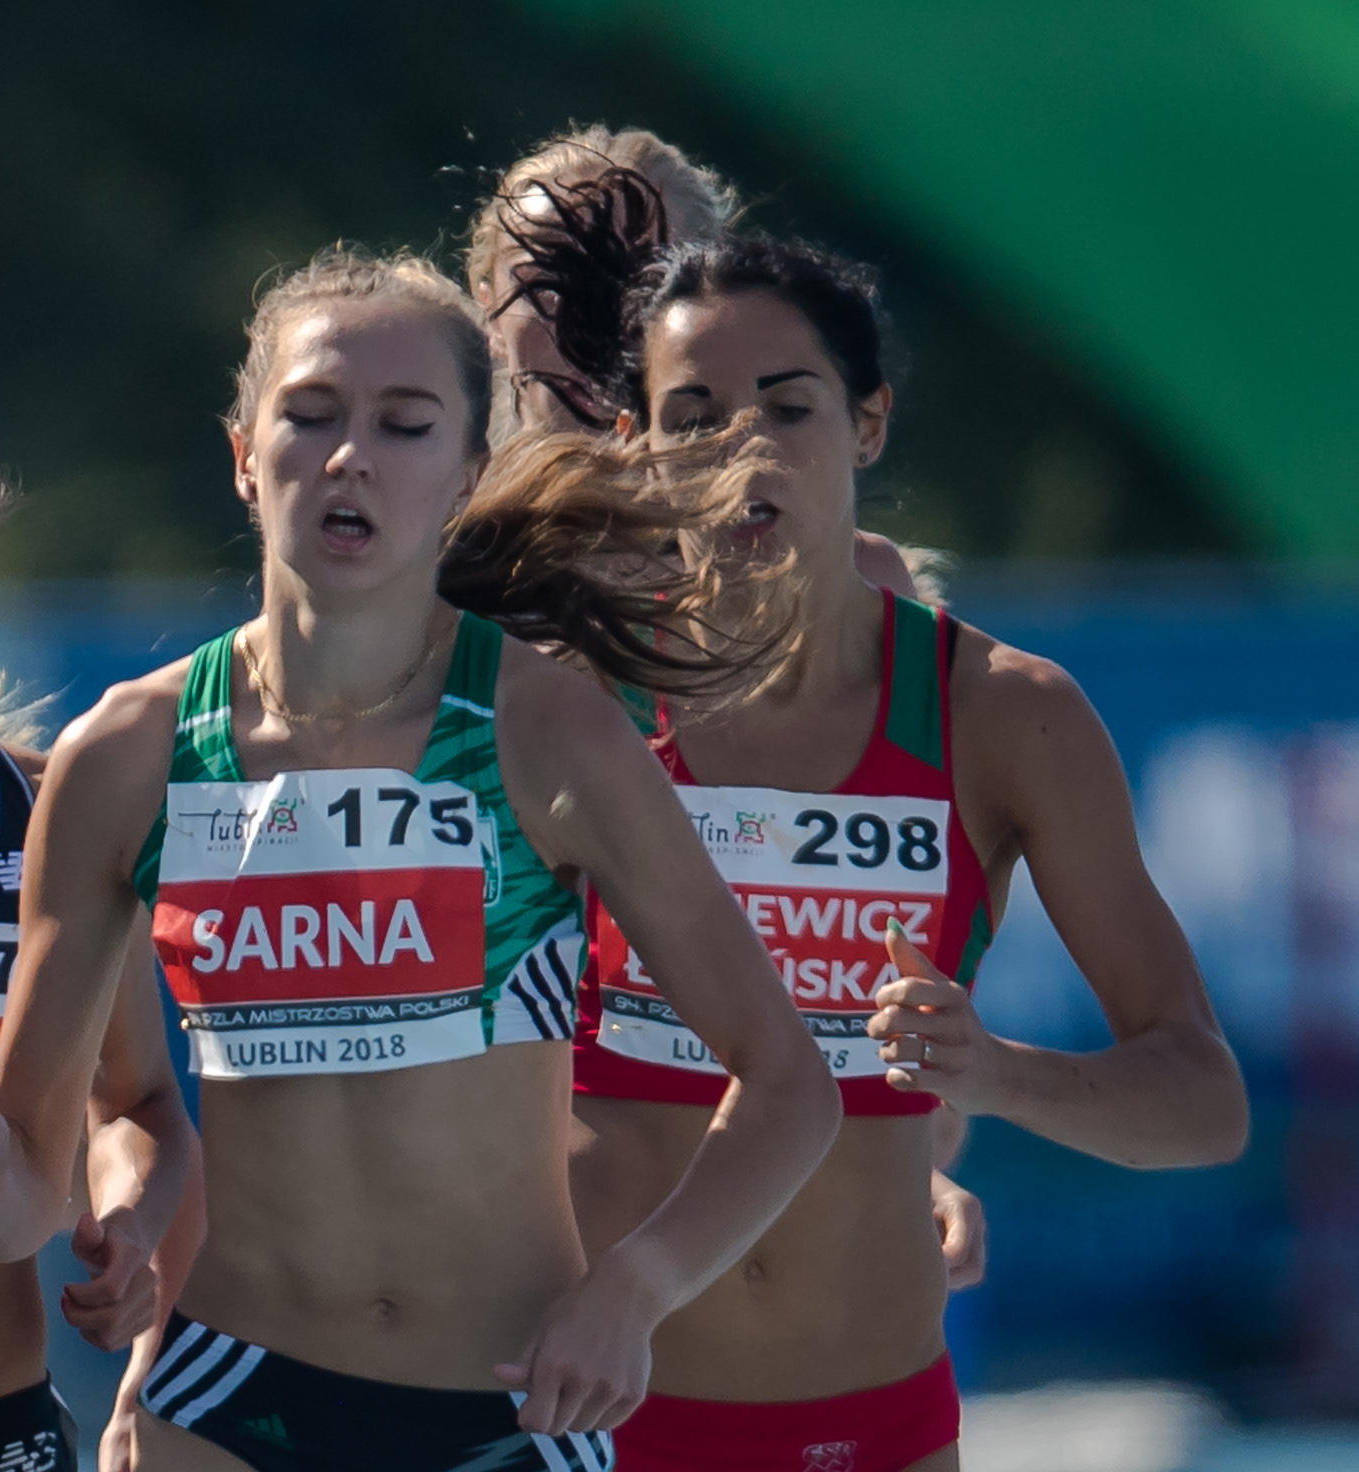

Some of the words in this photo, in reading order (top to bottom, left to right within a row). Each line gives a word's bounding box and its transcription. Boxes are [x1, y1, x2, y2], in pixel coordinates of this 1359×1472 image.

[327, 787, 474, 848] 175
[791, 809, 942, 872] 298
[192, 899, 434, 973] SARNA
[734, 893, 932, 944] EWICZ
[248, 1004, 395, 1024] MISTRZOSTWA
[399, 995, 470, 1017] POLSKI
[226, 1039, 327, 1067] LUBLIN
[338, 1034, 406, 1062] 2018
